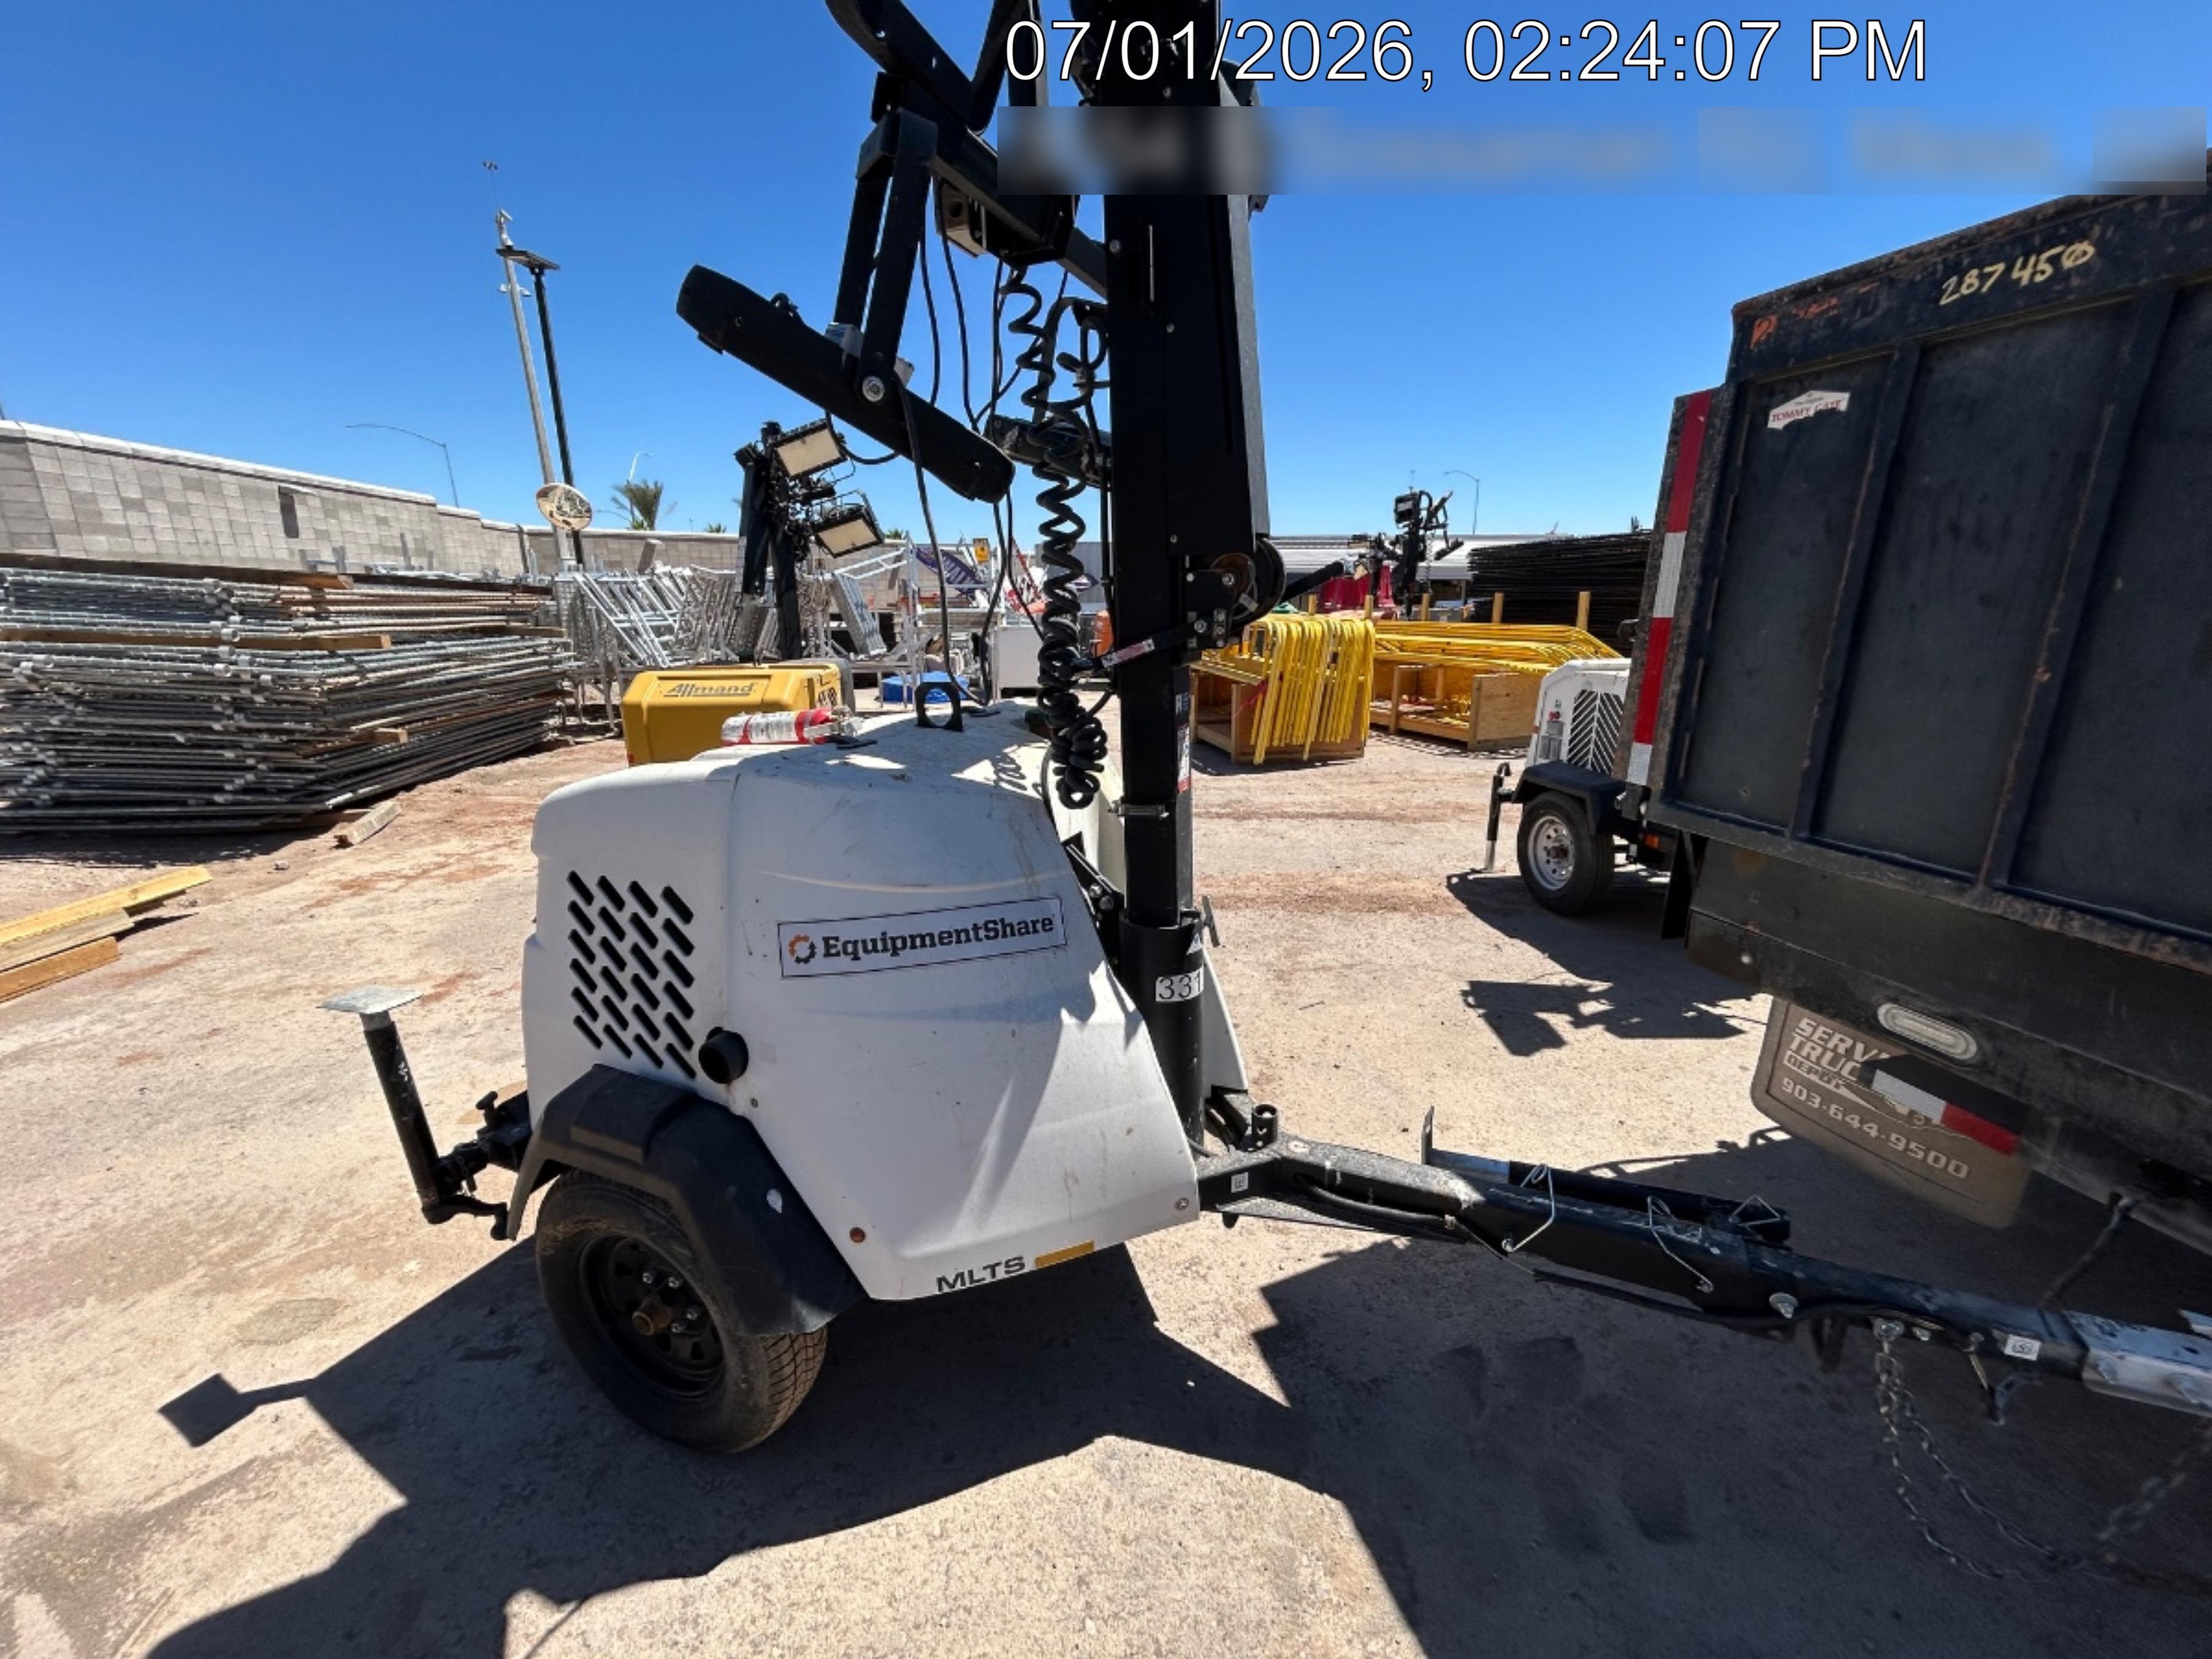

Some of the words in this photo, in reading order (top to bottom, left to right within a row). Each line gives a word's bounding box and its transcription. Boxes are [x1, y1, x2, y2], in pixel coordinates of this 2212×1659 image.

[1772, 407, 1811, 422] TOMMY
[667, 683, 753, 697] Allmand
[822, 916, 1054, 961] EquipmentShare
[1789, 1032, 1861, 1081] TRUC
[1795, 1017, 1892, 1062] SERV
[936, 1255, 1026, 1292] MLTS
